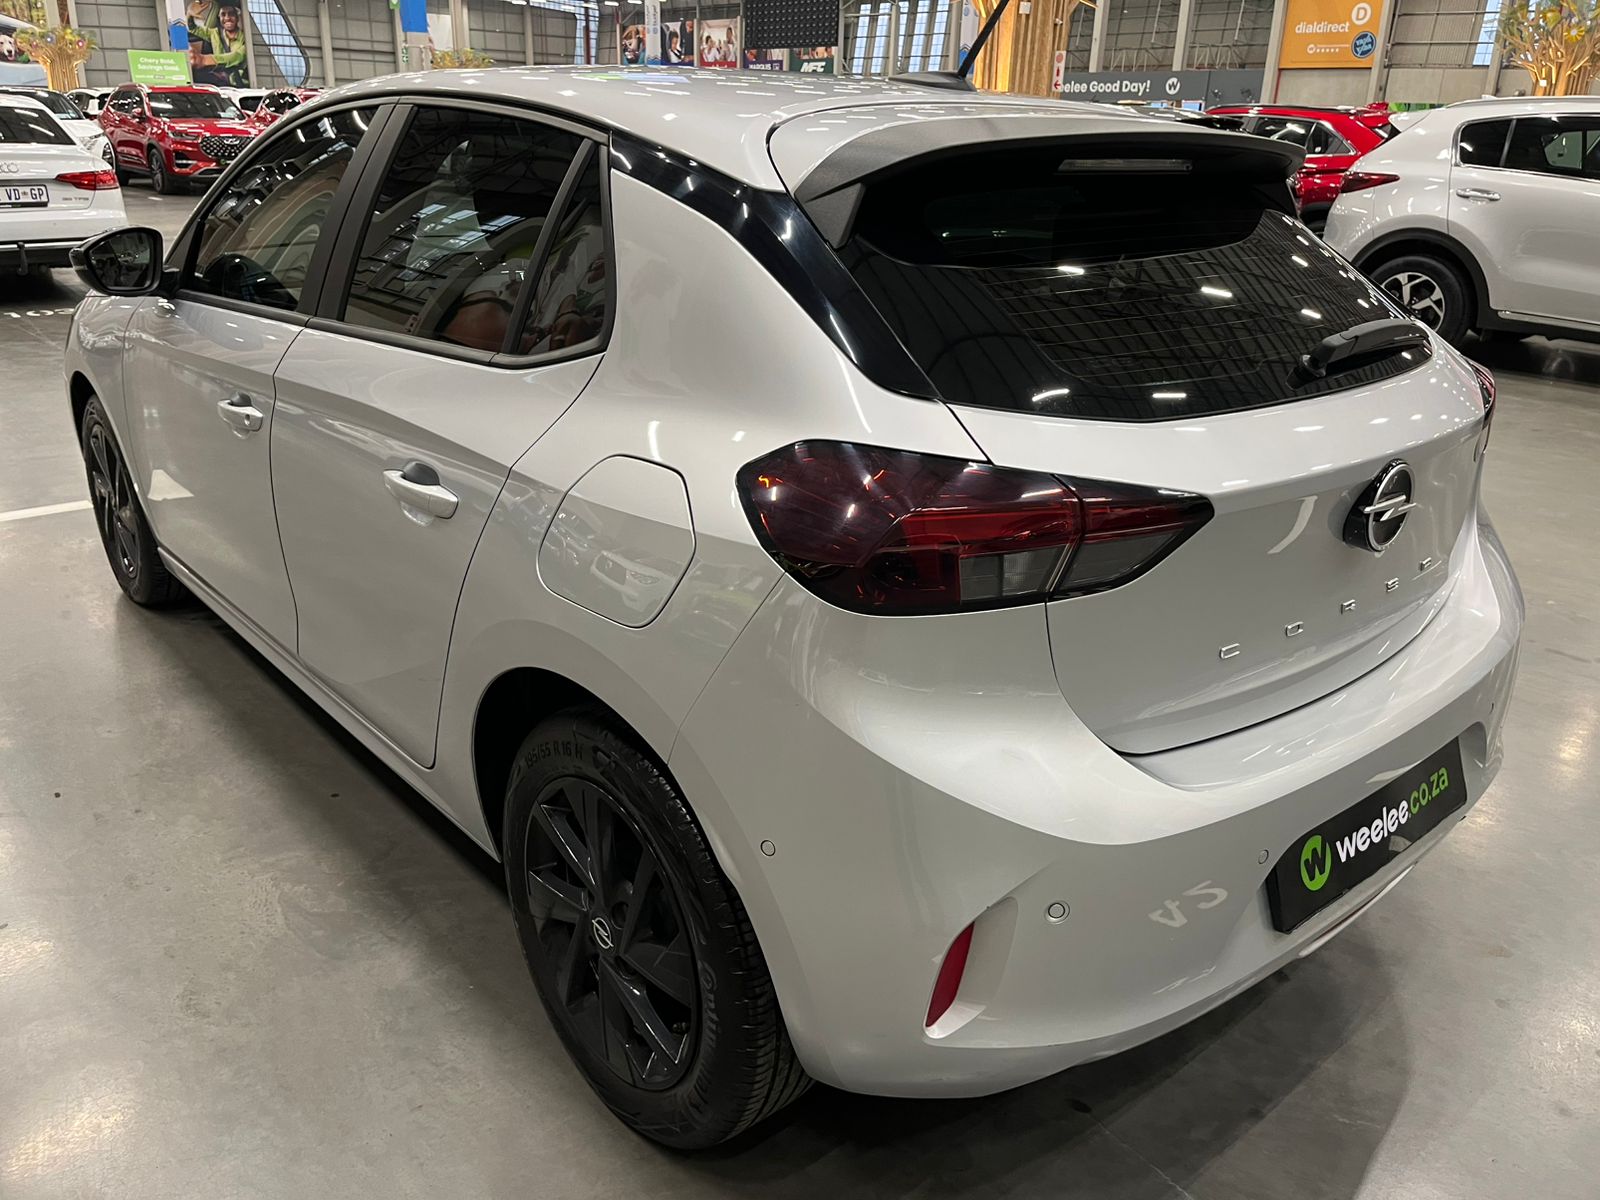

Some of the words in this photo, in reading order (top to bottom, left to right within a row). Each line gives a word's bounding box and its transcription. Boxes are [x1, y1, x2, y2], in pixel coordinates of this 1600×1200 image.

[1295, 21, 1350, 33] dialdirect
[800, 62, 826, 73] MFC
[1089, 80, 1120, 93] Good
[1121, 79, 1151, 96] Day!
[5, 188, 21, 201] VD
[30, 187, 44, 201] GP
[1335, 766, 1450, 864] weelee.co.za
